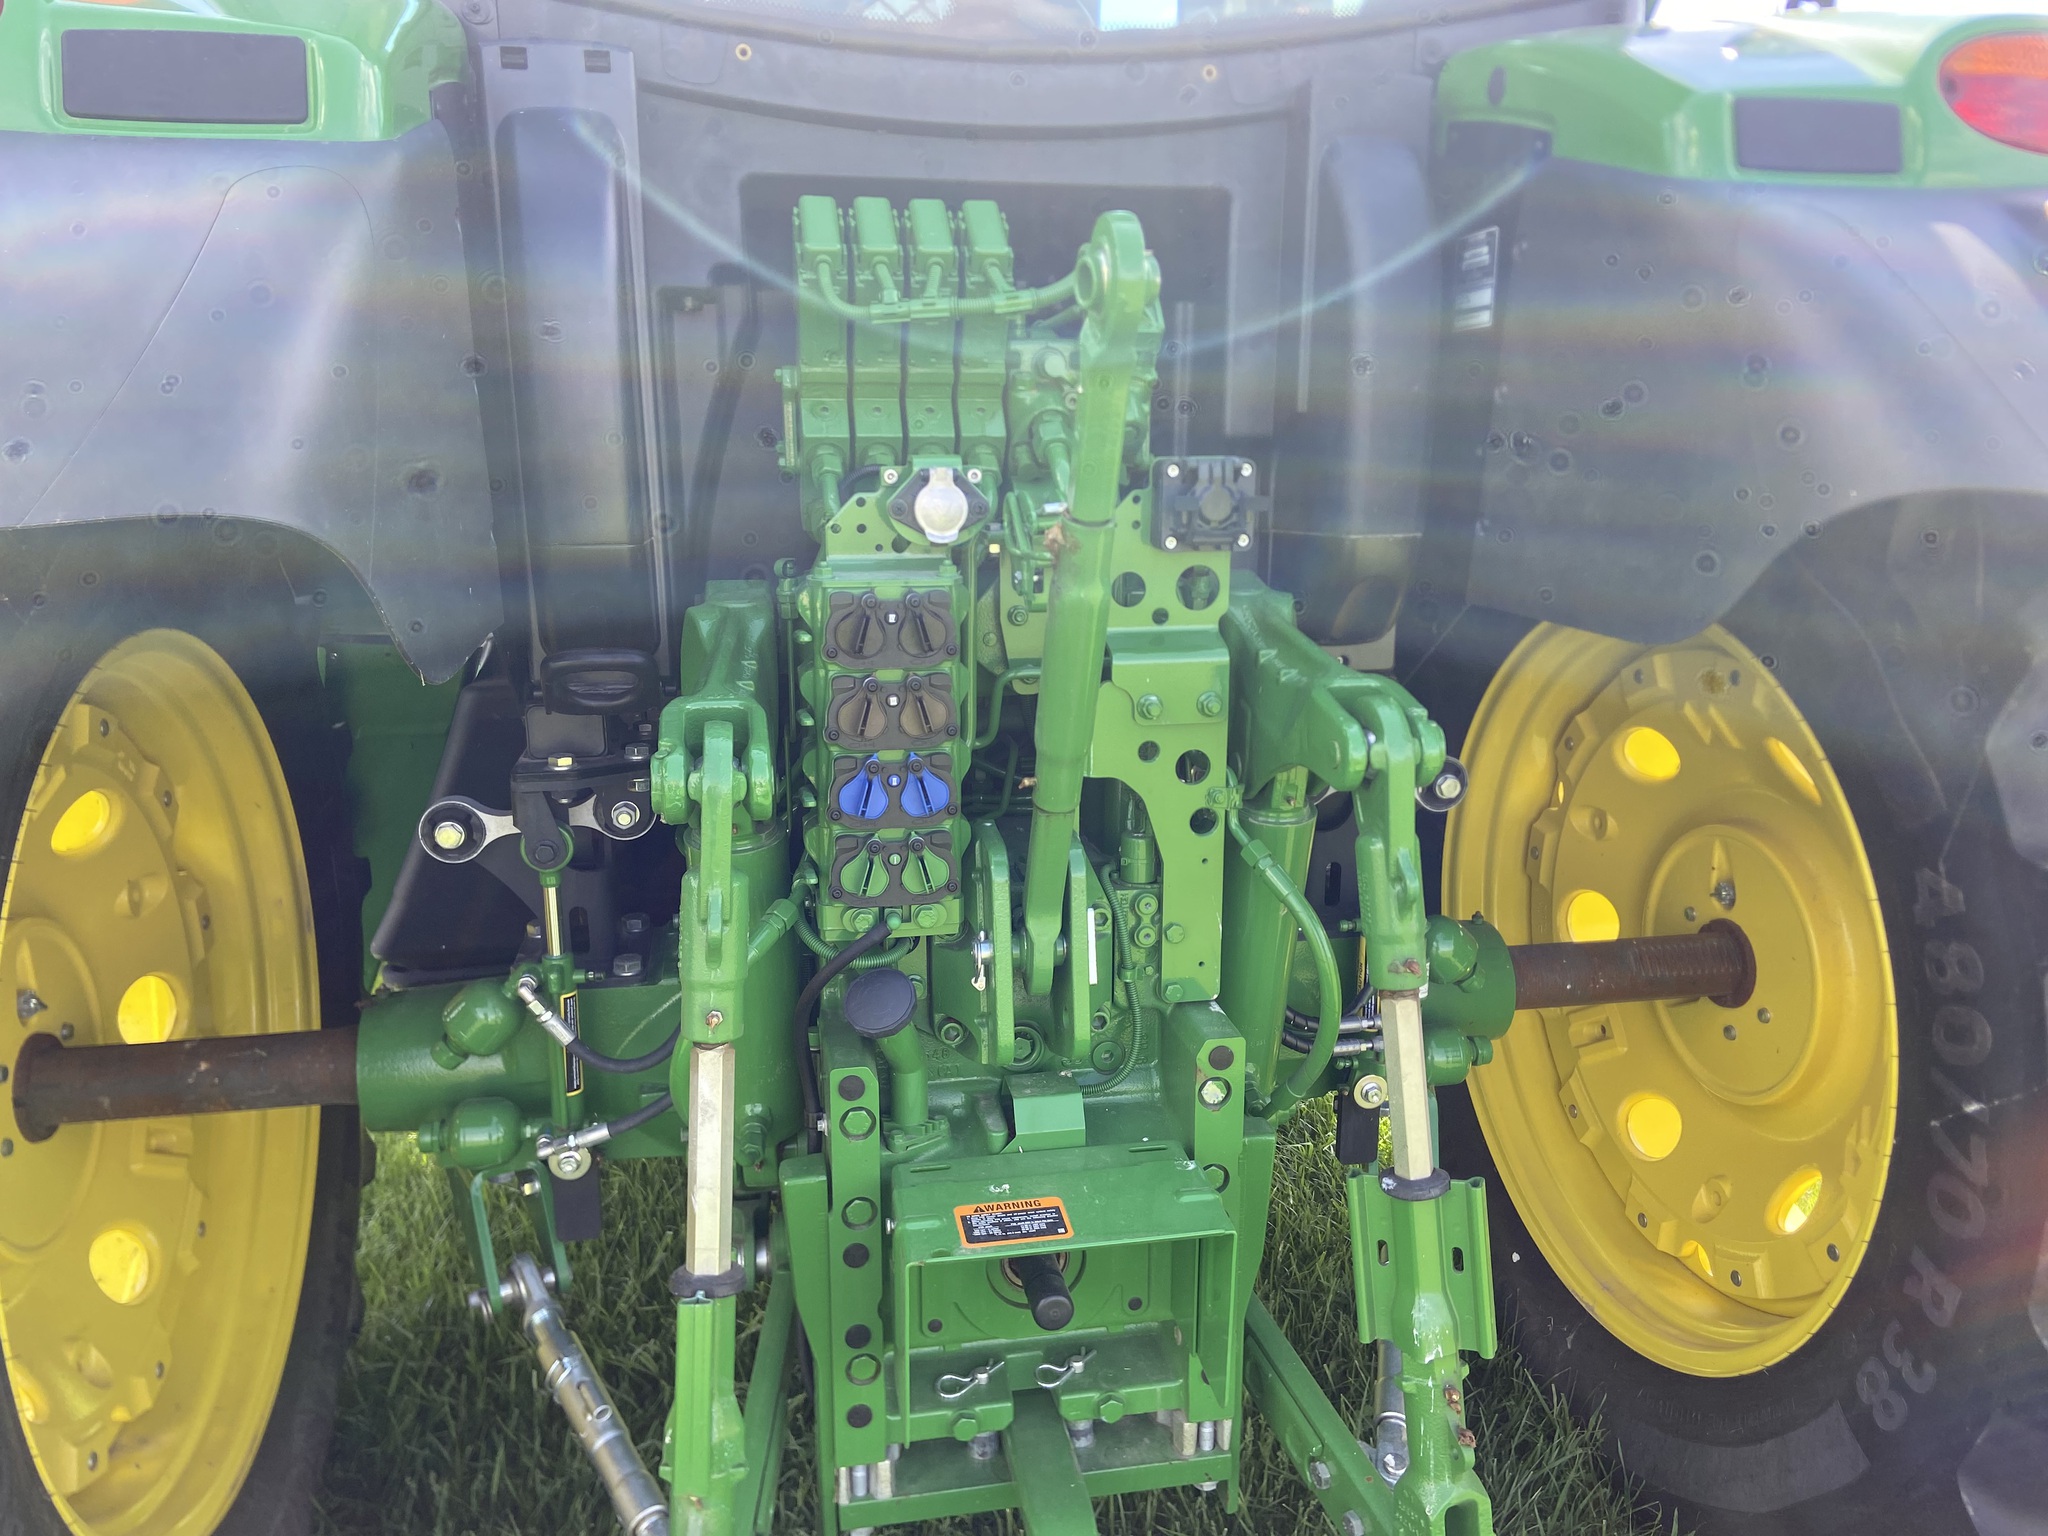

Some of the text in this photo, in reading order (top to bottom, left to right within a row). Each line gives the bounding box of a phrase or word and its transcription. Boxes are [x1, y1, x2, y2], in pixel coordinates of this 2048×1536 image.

[984, 1199, 1042, 1212] WARNING
[1855, 867, 1993, 1432] 480/70 R 38
